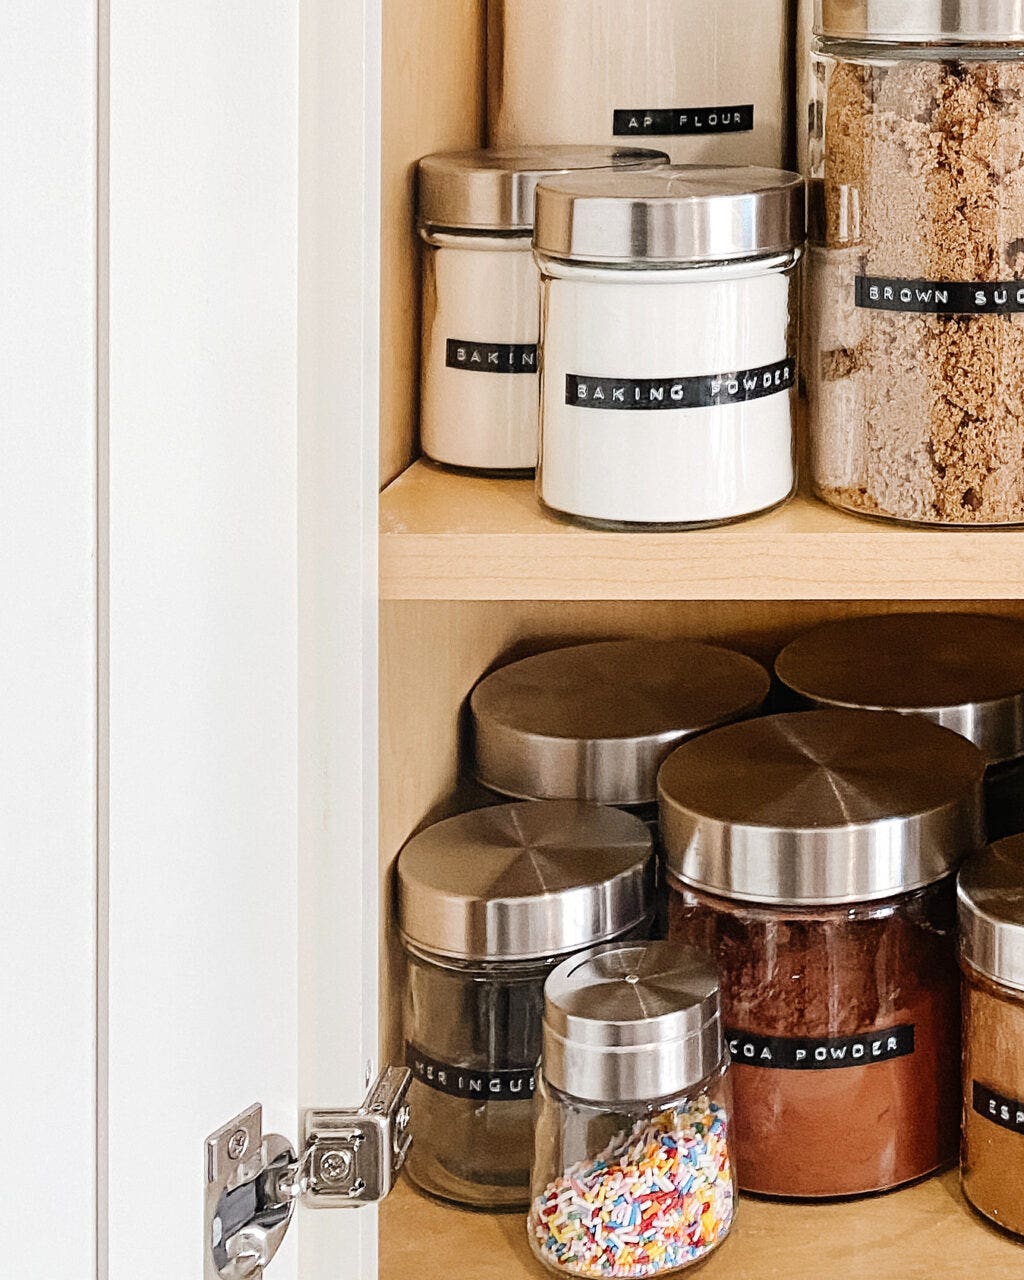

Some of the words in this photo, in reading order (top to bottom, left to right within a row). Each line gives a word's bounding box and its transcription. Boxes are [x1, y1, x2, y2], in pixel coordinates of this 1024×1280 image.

[628, 116, 653, 128] AP
[679, 112, 742, 127] FLOUR
[868, 285, 949, 304] BROWN
[577, 383, 684, 402] BAKING
[710, 366, 790, 396] POWDER
[795, 1036, 898, 1061] POWDER
